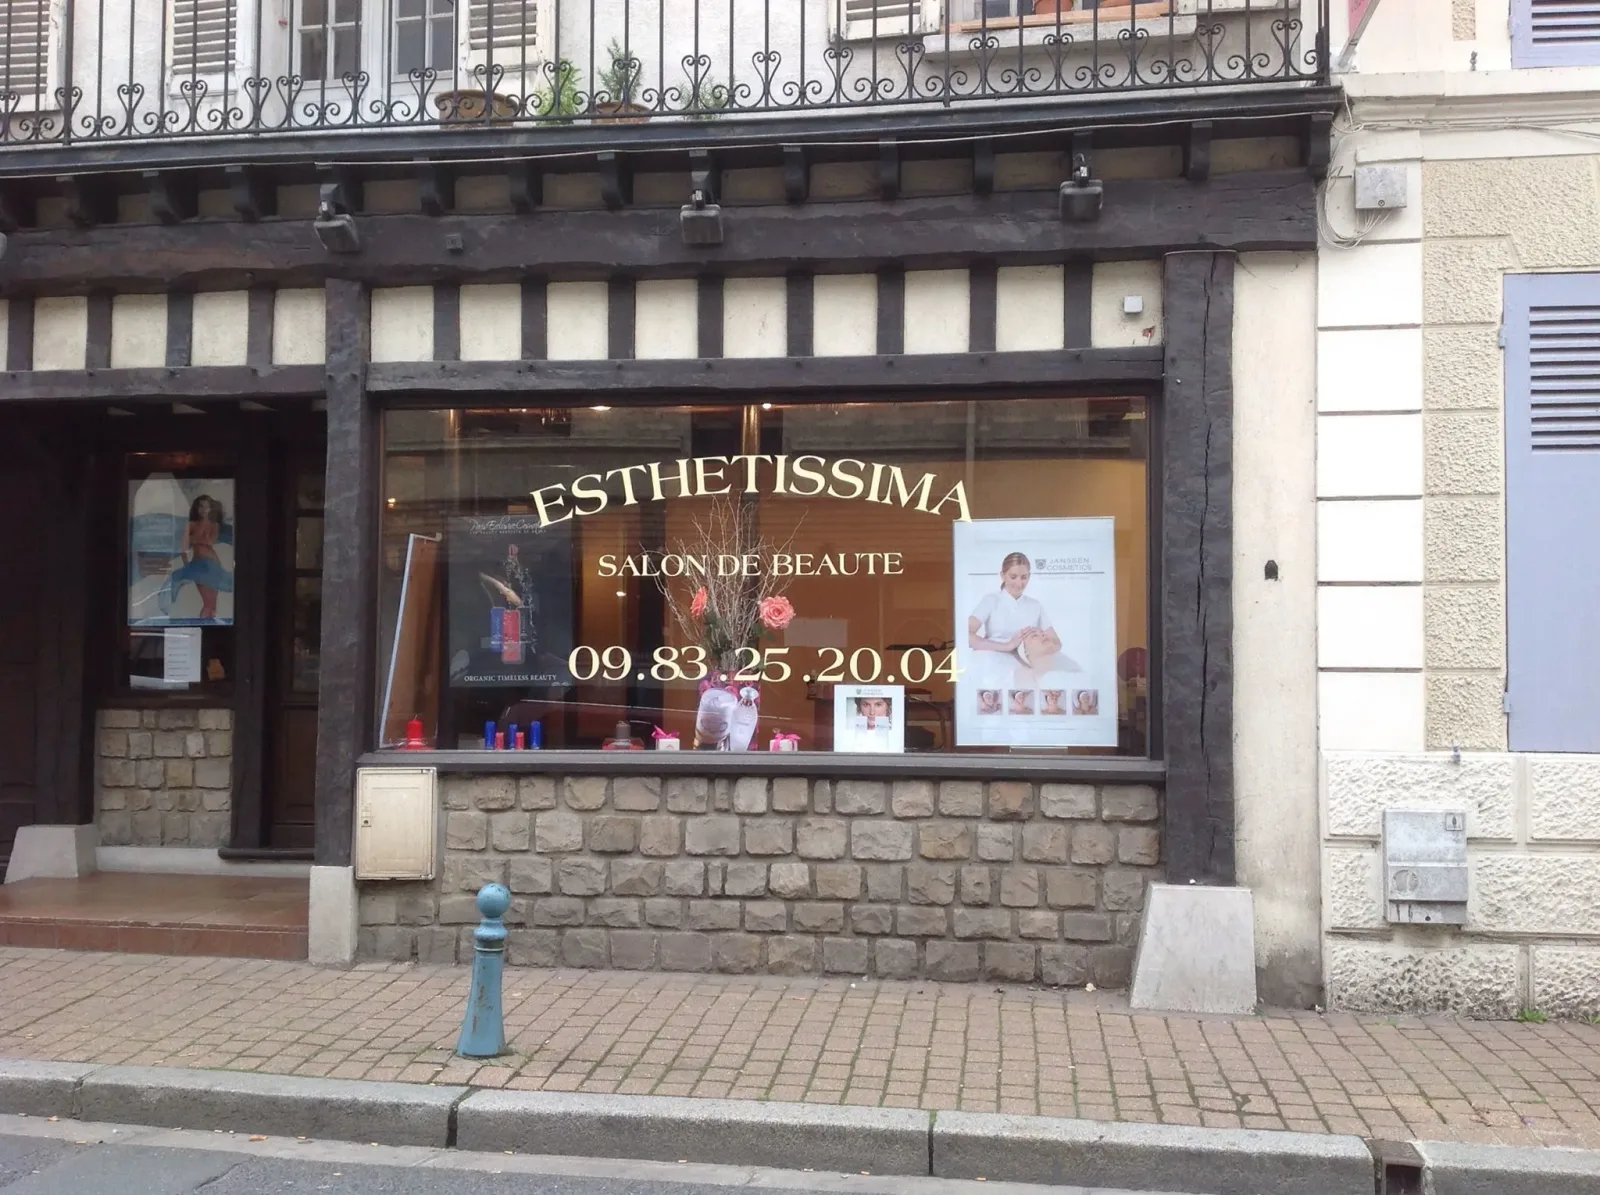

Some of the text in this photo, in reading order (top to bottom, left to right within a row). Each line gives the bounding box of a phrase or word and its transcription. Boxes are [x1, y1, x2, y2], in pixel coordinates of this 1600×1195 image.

[530, 455, 973, 527] ESTHETISSIMA
[598, 552, 905, 577] SALON DE BEAUTE
[530, 674, 557, 682] BEAUTY
